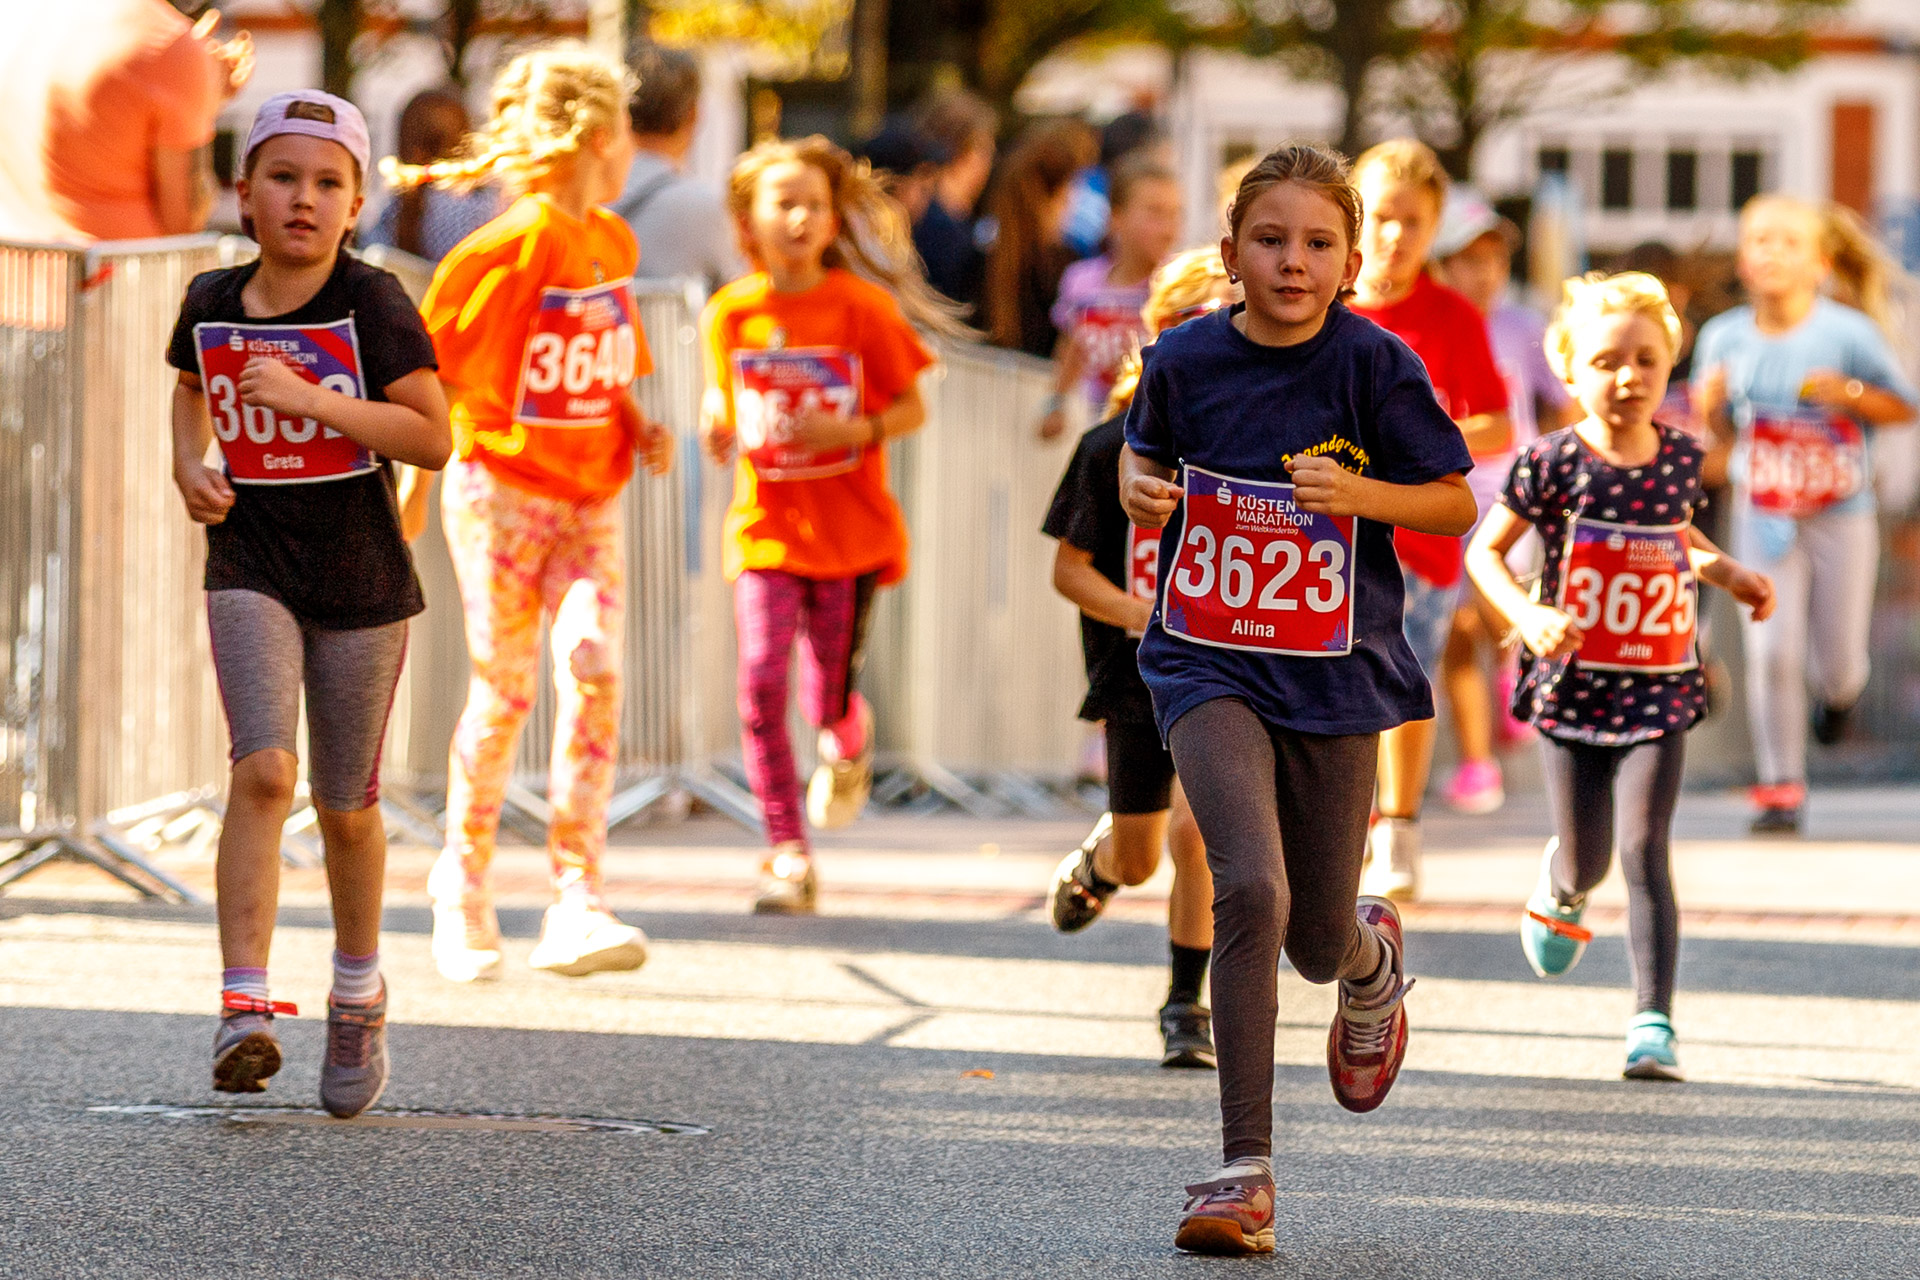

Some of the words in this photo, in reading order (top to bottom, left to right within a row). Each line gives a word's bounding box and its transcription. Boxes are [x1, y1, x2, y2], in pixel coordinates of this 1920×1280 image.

[263, 453, 305, 470] Greta
[1237, 494, 1296, 513] KÜSTEN
[1236, 509, 1314, 527] MARATHON
[1250, 525, 1299, 536] Weltkindertag
[1175, 525, 1346, 613] 3623
[1566, 567, 1695, 636] 3625
[1231, 619, 1275, 638] Alina
